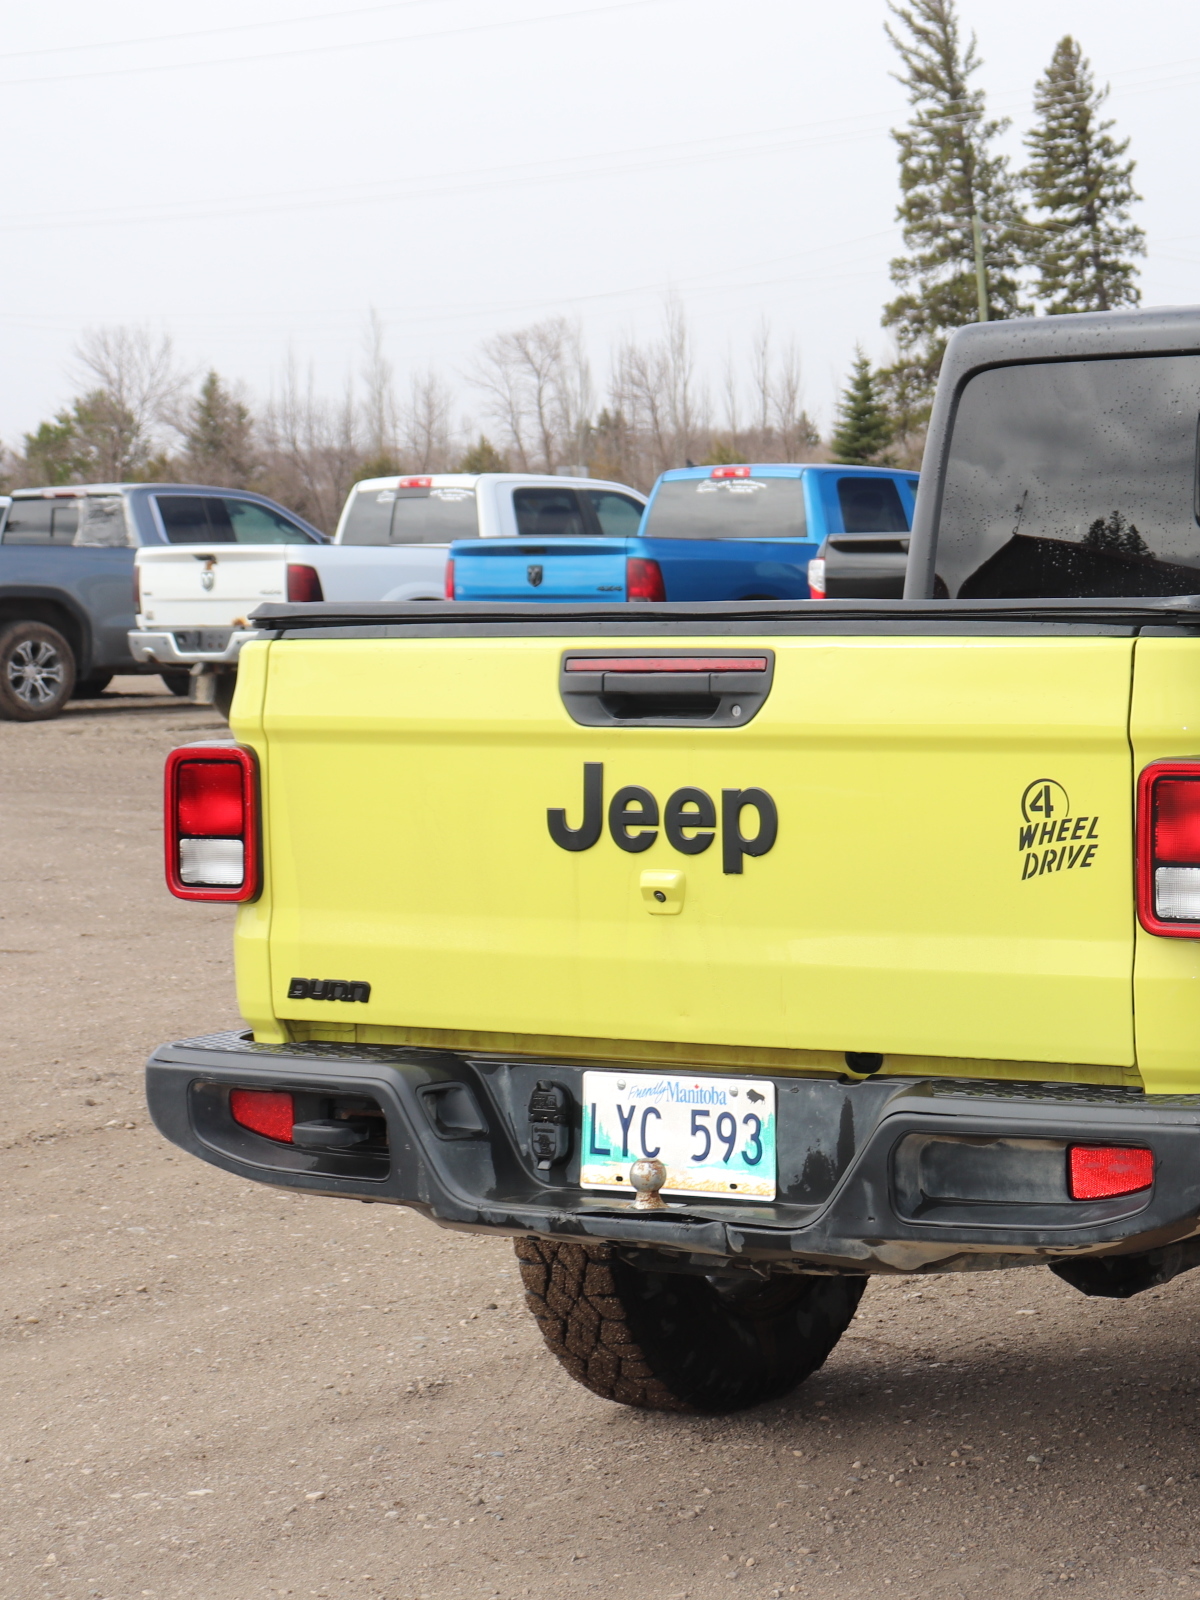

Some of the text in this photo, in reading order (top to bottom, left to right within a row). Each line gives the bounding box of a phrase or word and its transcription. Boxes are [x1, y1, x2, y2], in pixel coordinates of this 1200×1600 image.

[546, 761, 778, 875] Jeep
[1029, 785, 1054, 818] 4
[1019, 816, 1099, 851] WHEEL
[1021, 844, 1099, 880] DRIVE
[665, 1081, 727, 1106] Manitoba
[590, 1102, 763, 1166] LYC 593
